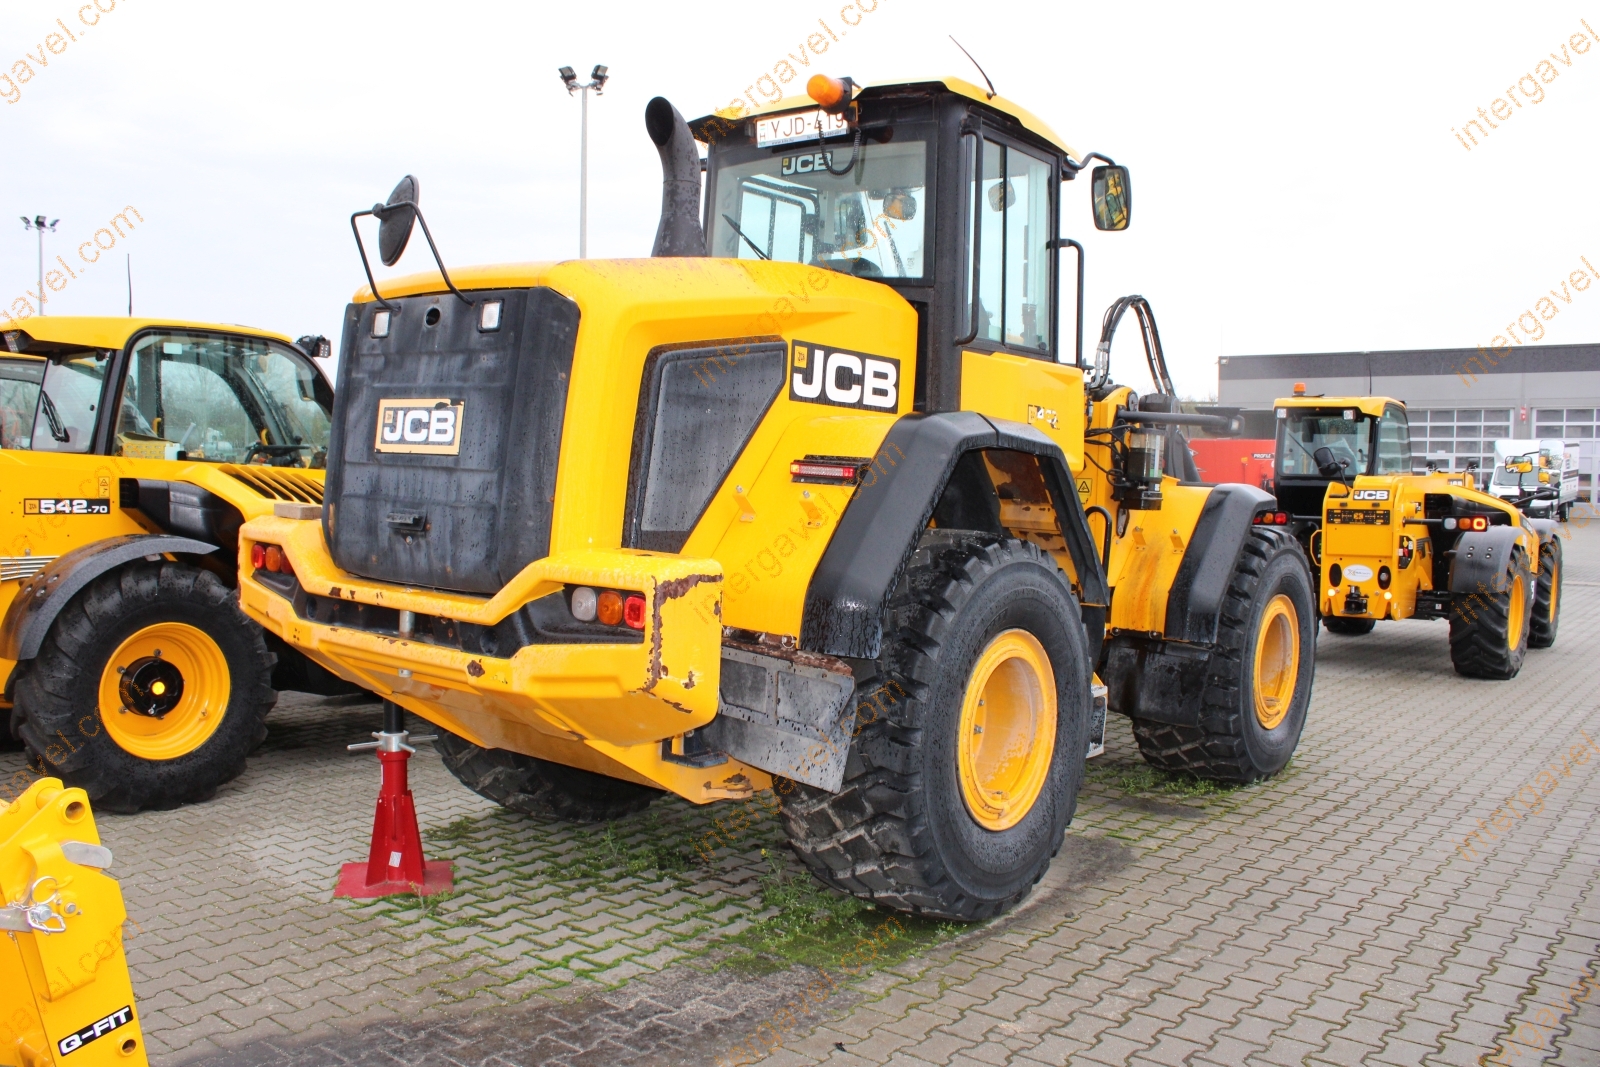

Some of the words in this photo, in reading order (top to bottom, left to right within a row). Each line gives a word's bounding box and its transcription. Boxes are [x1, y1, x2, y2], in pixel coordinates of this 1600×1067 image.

[771, 111, 844, 139] YJD-419
[782, 152, 832, 175] JCB
[793, 349, 897, 408] JCB
[383, 410, 456, 442] JCB
[40, 499, 109, 514] 542-70
[1353, 490, 1389, 500] JCB
[60, 1006, 130, 1054] Q-FIT
